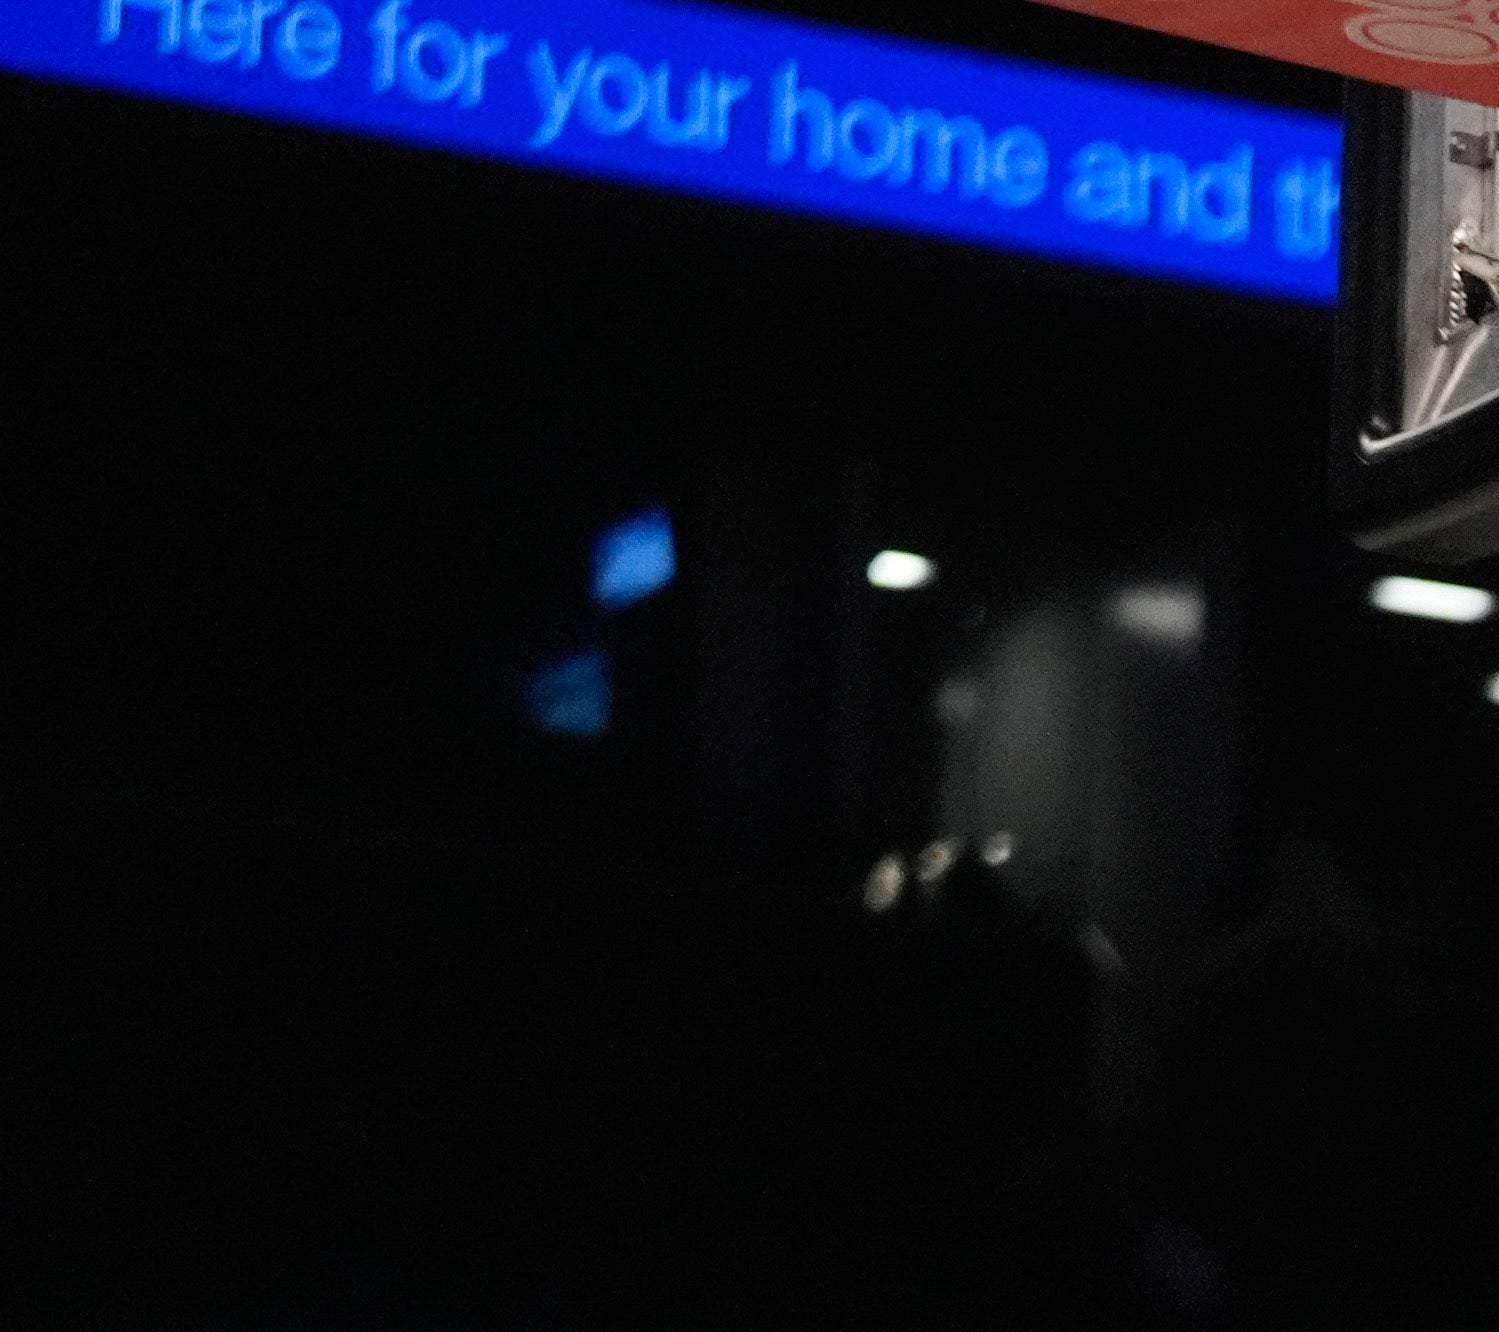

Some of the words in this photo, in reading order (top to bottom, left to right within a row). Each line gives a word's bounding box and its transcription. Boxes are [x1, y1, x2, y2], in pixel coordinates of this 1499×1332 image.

[370, 0, 508, 108] for
[528, 39, 750, 152] your
[767, 59, 1047, 208] home
[1064, 142, 1253, 243] and
[1275, 159, 1341, 259] th
